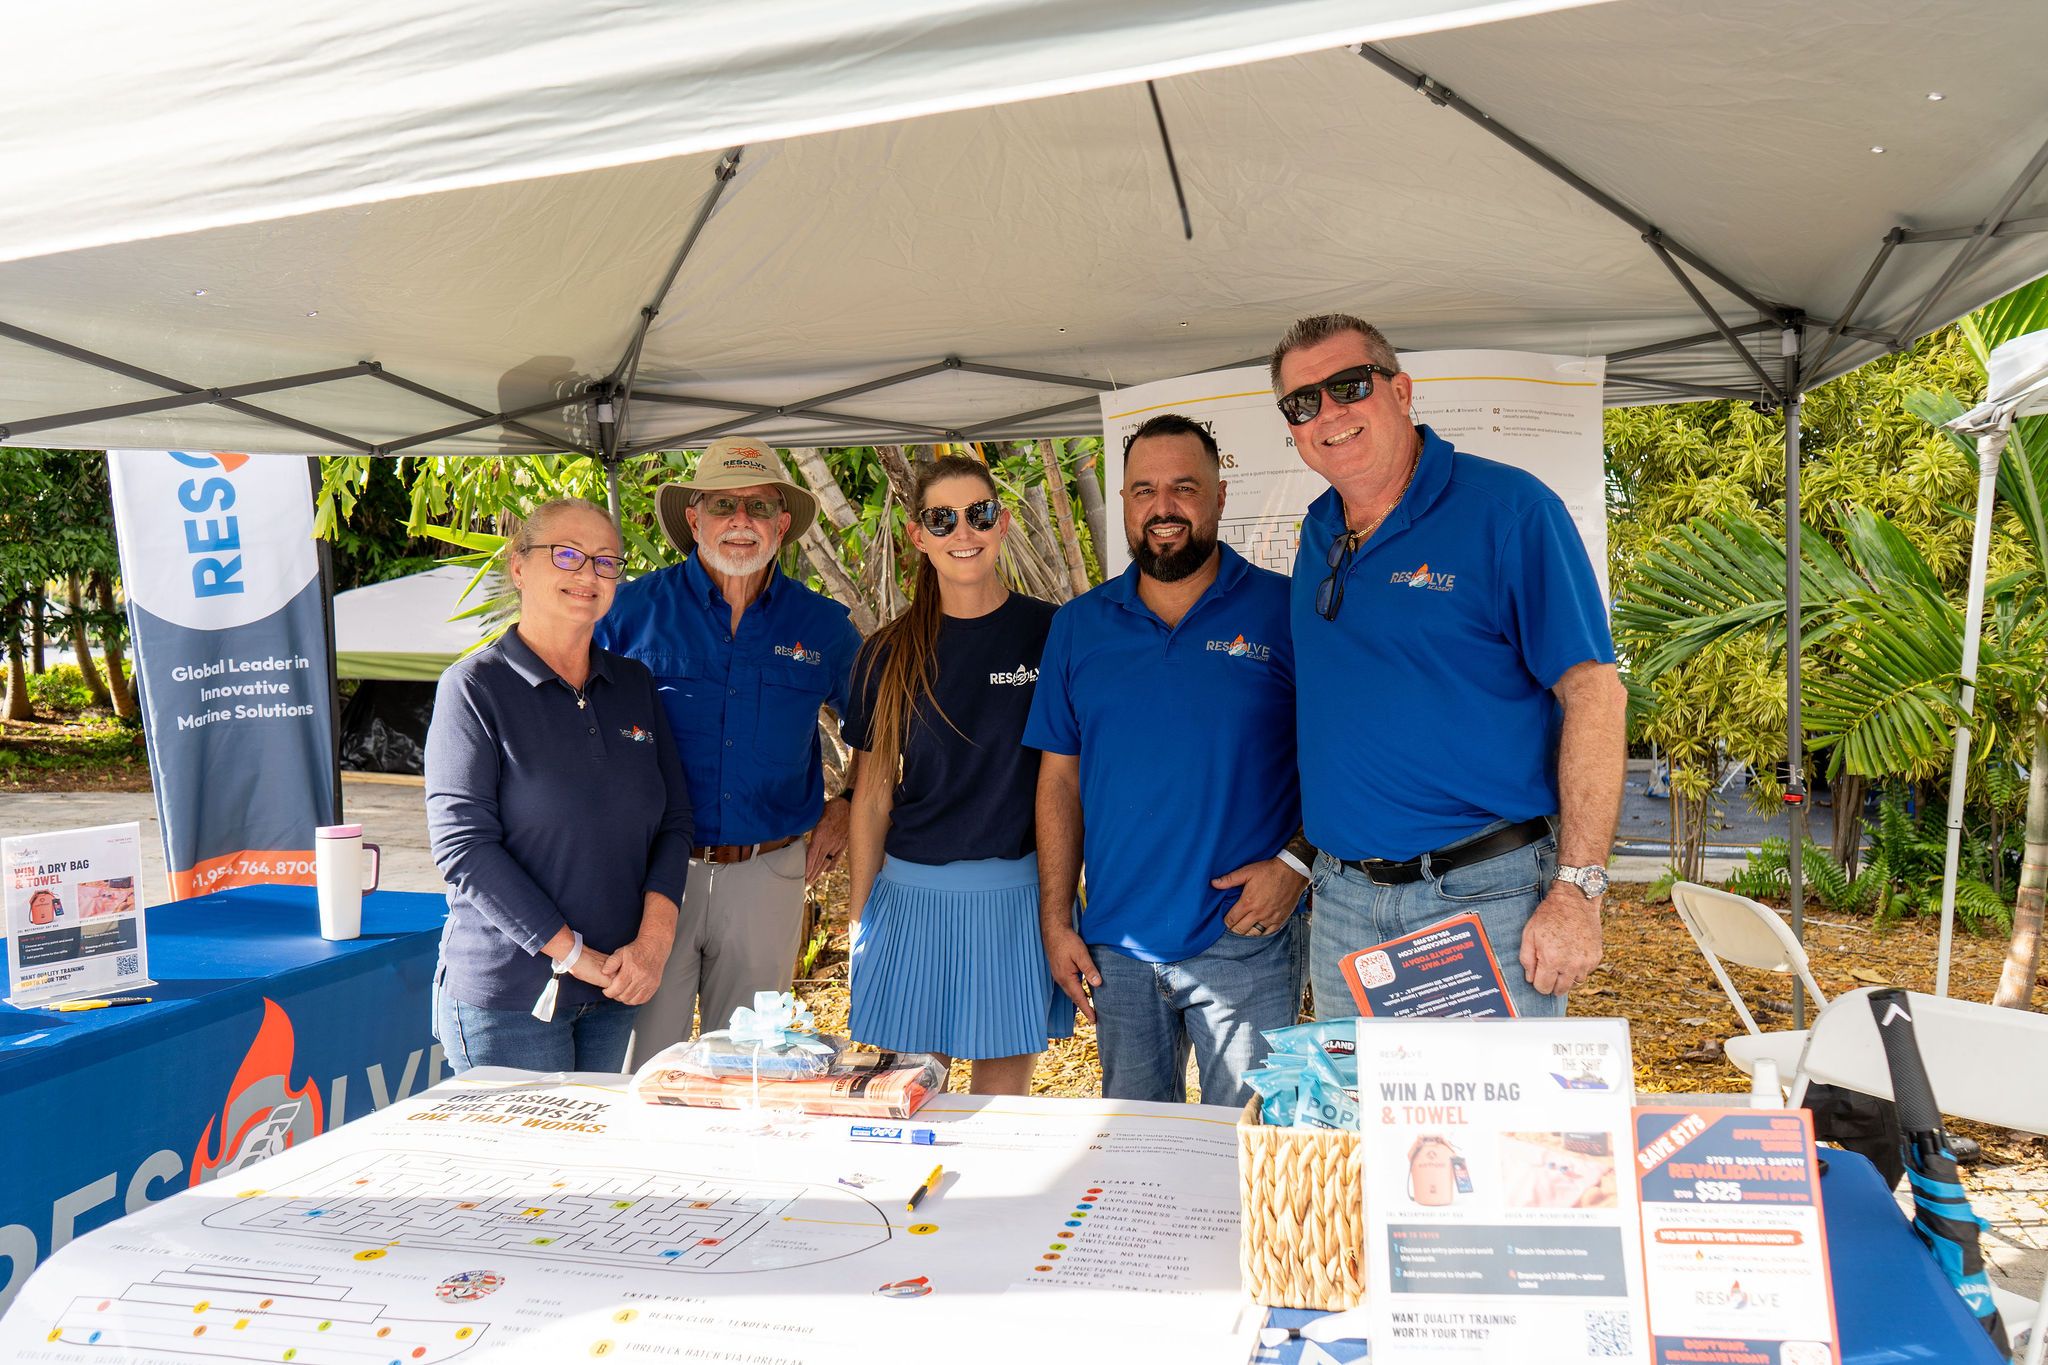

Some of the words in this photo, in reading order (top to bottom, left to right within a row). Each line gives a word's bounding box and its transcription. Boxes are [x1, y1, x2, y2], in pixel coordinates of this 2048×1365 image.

[724, 460, 767, 470] RESOLVE
[1390, 564, 1456, 588] RESOLVE
[774, 642, 821, 662] RESOLVE
[1206, 635, 1271, 658] RESOLVE
[172, 659, 224, 682] Global
[229, 656, 292, 673] Leader
[295, 655, 309, 669] in
[201, 681, 289, 702] Innovative
[177, 708, 231, 731] Marine
[235, 703, 313, 719] Solutions
[14, 865, 34, 878] WIN
[37, 865, 45, 875] A
[46, 861, 67, 874] DRY
[69, 858, 89, 871] BAG
[14, 880, 23, 889] &
[26, 873, 62, 888] TOWEL
[1398, 931, 1471, 958] RESOLVEACADEMY.COM
[1430, 941, 1475, 960] REVALIDATE
[1402, 954, 1430, 968] TODAY!
[1441, 953, 1464, 965] DON'T
[36, 969, 59, 978] QUALITY
[60, 965, 84, 974] TRAINING
[1324, 1039, 1355, 1051] KLAND
[1380, 1082, 1419, 1102] WIN
[1424, 1082, 1436, 1102] A
[1442, 1083, 1476, 1102] DRY
[1485, 1083, 1521, 1102] BAG
[448, 1094, 494, 1102] ONE
[495, 1094, 611, 1112] CASUALTY.
[430, 1103, 504, 1112] THREE
[504, 1104, 568, 1119] WAYS
[569, 1113, 596, 1122] IN.
[1381, 1106, 1396, 1125] &
[1403, 1106, 1469, 1125] TOWEL
[407, 1113, 457, 1121] ONE
[459, 1113, 523, 1124] THAT
[520, 1117, 609, 1133] WORKS.
[871, 1127, 902, 1139] EXPO
[1636, 1136, 1675, 1170] SAVE
[1767, 1157, 1805, 1167] SAFETY
[1668, 1163, 1806, 1181] REVALIDATION
[1142, 1192, 1176, 1200] GALLEY
[1695, 1180, 1742, 1202] $525
[1104, 1198, 1153, 1207] EXPLOSION
[1132, 1209, 1171, 1218] INGRESS
[1094, 1214, 1128, 1222] HAZMAT
[1172, 1223, 1198, 1231] CHEM
[1115, 1225, 1138, 1233] LEAK
[1153, 1230, 1191, 1238] BUNKER
[1079, 1238, 1146, 1249] SWITCHBOARD
[1106, 1235, 1164, 1245] ELECTRICAL
[1067, 1256, 1117, 1265] CONFINED
[1120, 1260, 1151, 1268] SPACE
[1138, 1253, 1189, 1261] VISIBILITY
[1061, 1265, 1123, 1275] STRUCTURAL
[1129, 1271, 1180, 1280] COLLAPSE
[622, 1291, 660, 1300] ENTRY
[664, 1296, 706, 1304] POINTS
[619, 1312, 629, 1321] A
[649, 1312, 682, 1321] BEACH
[728, 1319, 770, 1329] TENDER
[772, 1324, 815, 1334] GARAGE
[1392, 1312, 1422, 1324] WANT
[1423, 1313, 1465, 1325] QUALITY
[1469, 1314, 1517, 1326] TRAINING
[1392, 1326, 1428, 1338] WORTH
[1431, 1327, 1459, 1339] YOUR
[1460, 1328, 1490, 1340] TIME?
[596, 1344, 608, 1354] B
[685, 1349, 720, 1360] HATCH
[725, 1353, 742, 1362] VIA
